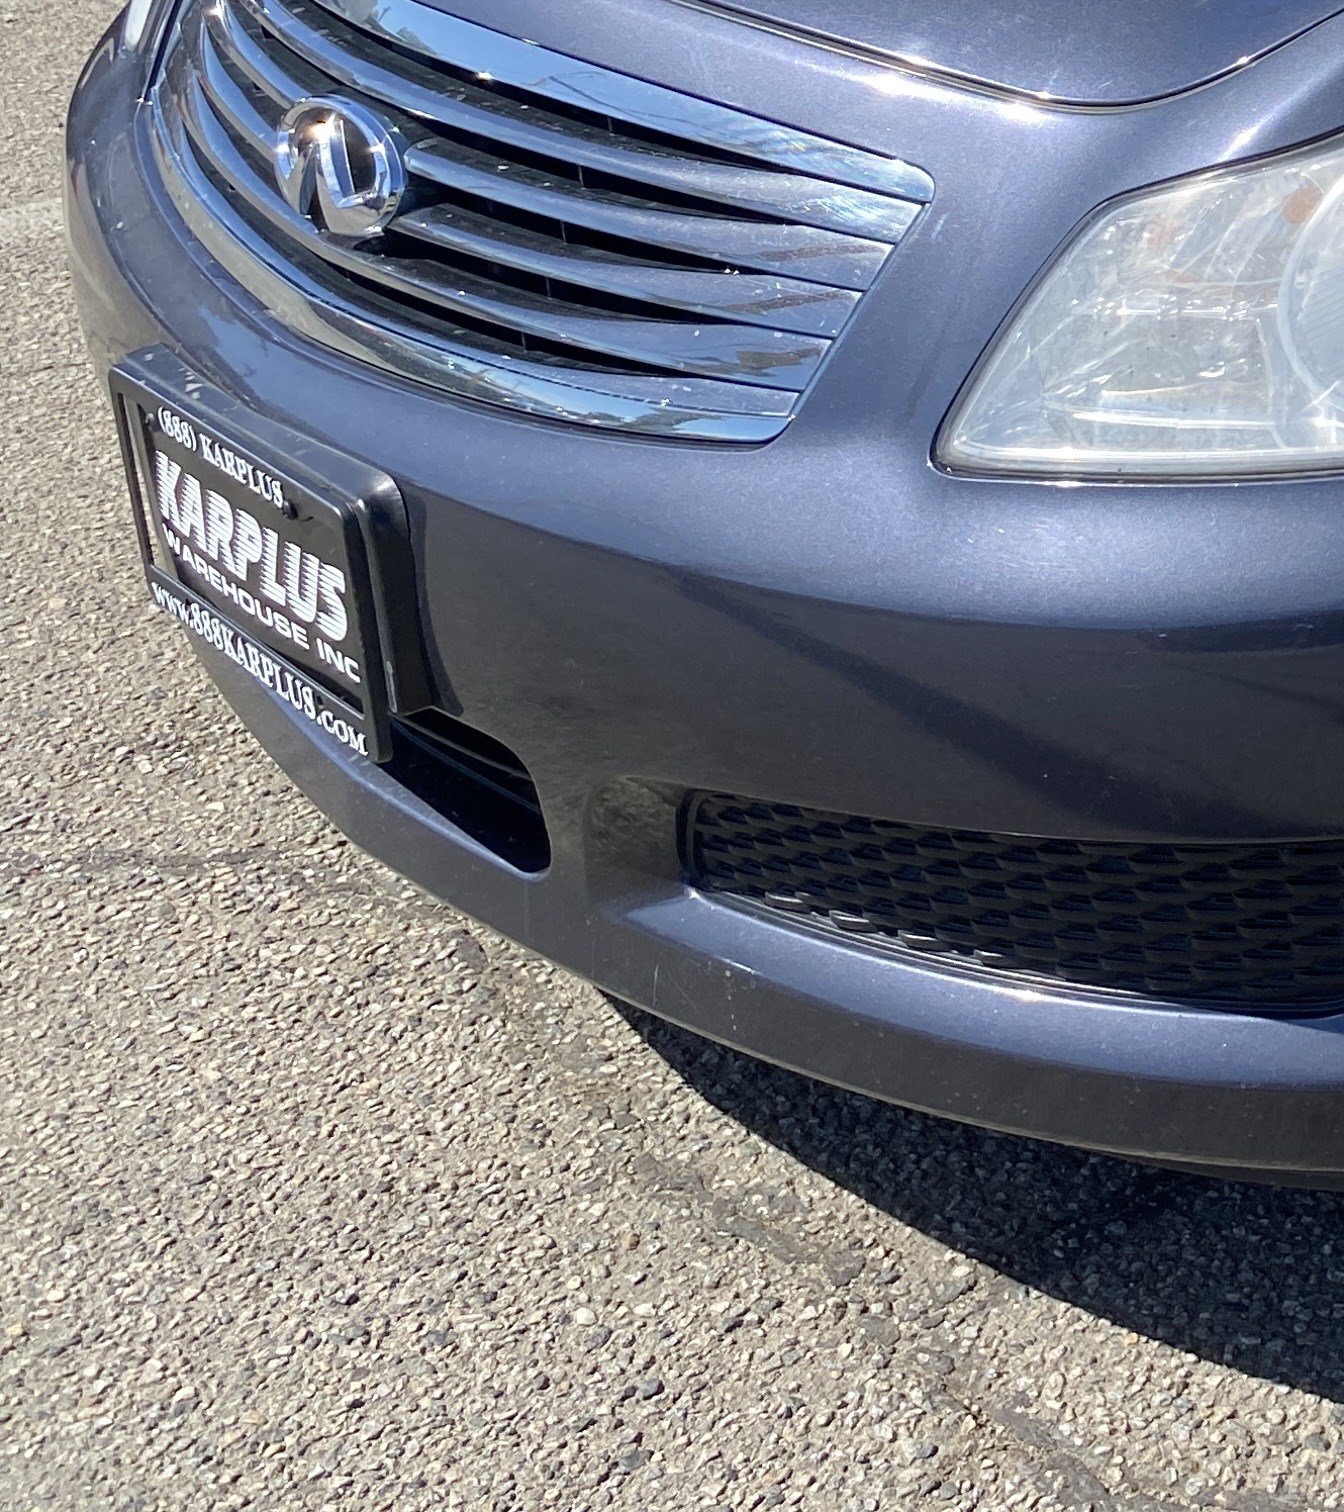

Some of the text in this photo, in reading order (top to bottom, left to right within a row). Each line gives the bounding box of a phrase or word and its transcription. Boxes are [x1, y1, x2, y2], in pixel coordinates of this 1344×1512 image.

[158, 405, 285, 508] (888) KARPLUS
[156, 449, 348, 642] KARPLUS
[162, 524, 362, 684] WAREHOUSE INC
